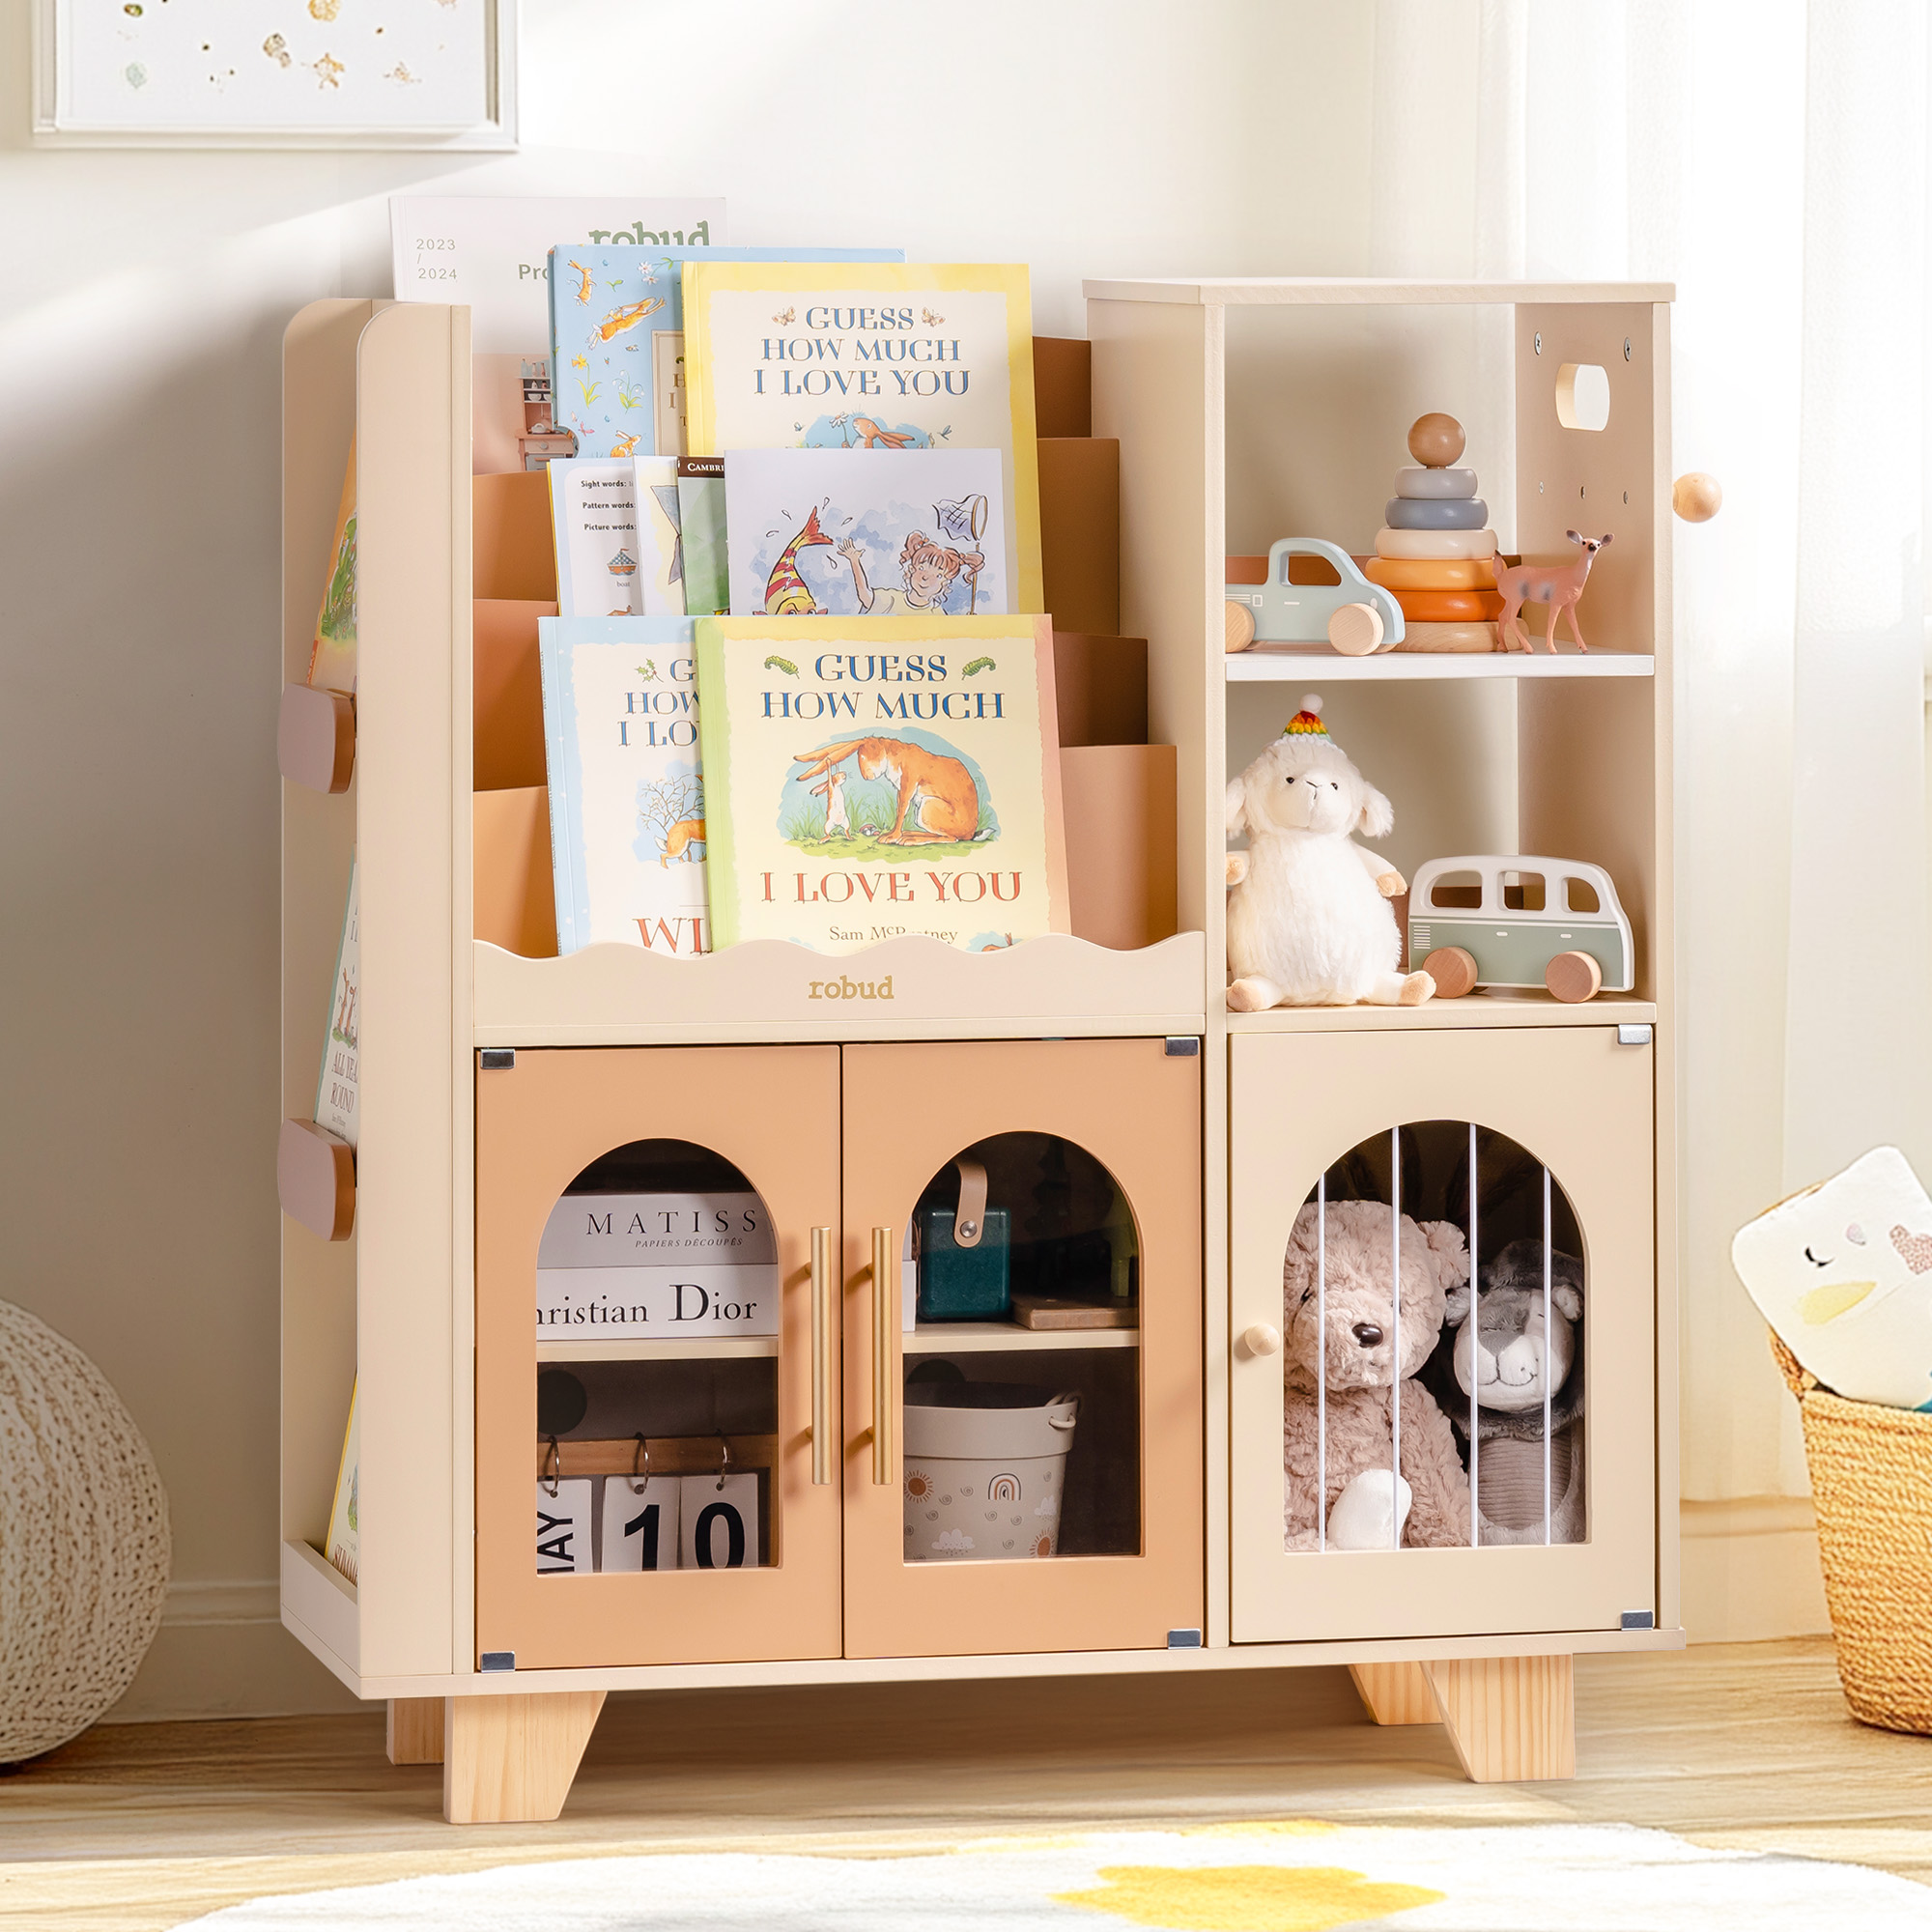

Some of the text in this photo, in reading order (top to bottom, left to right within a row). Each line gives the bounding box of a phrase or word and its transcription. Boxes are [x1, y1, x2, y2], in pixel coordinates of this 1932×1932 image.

[416, 238, 456, 250] 2023
[418, 268, 458, 280] 2024
[806, 306, 915, 331] GUESS
[760, 338, 961, 362] HOW MUCH
[753, 369, 970, 397] I LOVE YOU
[669, 658, 697, 682] G
[814, 654, 948, 682] GUESS
[761, 691, 1006, 720] HOW MUCH
[617, 720, 699, 748] I LO
[760, 871, 1023, 905] I LOVE YOU
[829, 926, 864, 940] Sam
[808, 975, 895, 1000] robud
[330, 1082, 355, 1114] ROUND
[585, 1209, 773, 1236] MATISS
[635, 1238, 680, 1248] PAPIERS
[668, 1283, 757, 1321] Dior
[537, 1510, 575, 1575] AY
